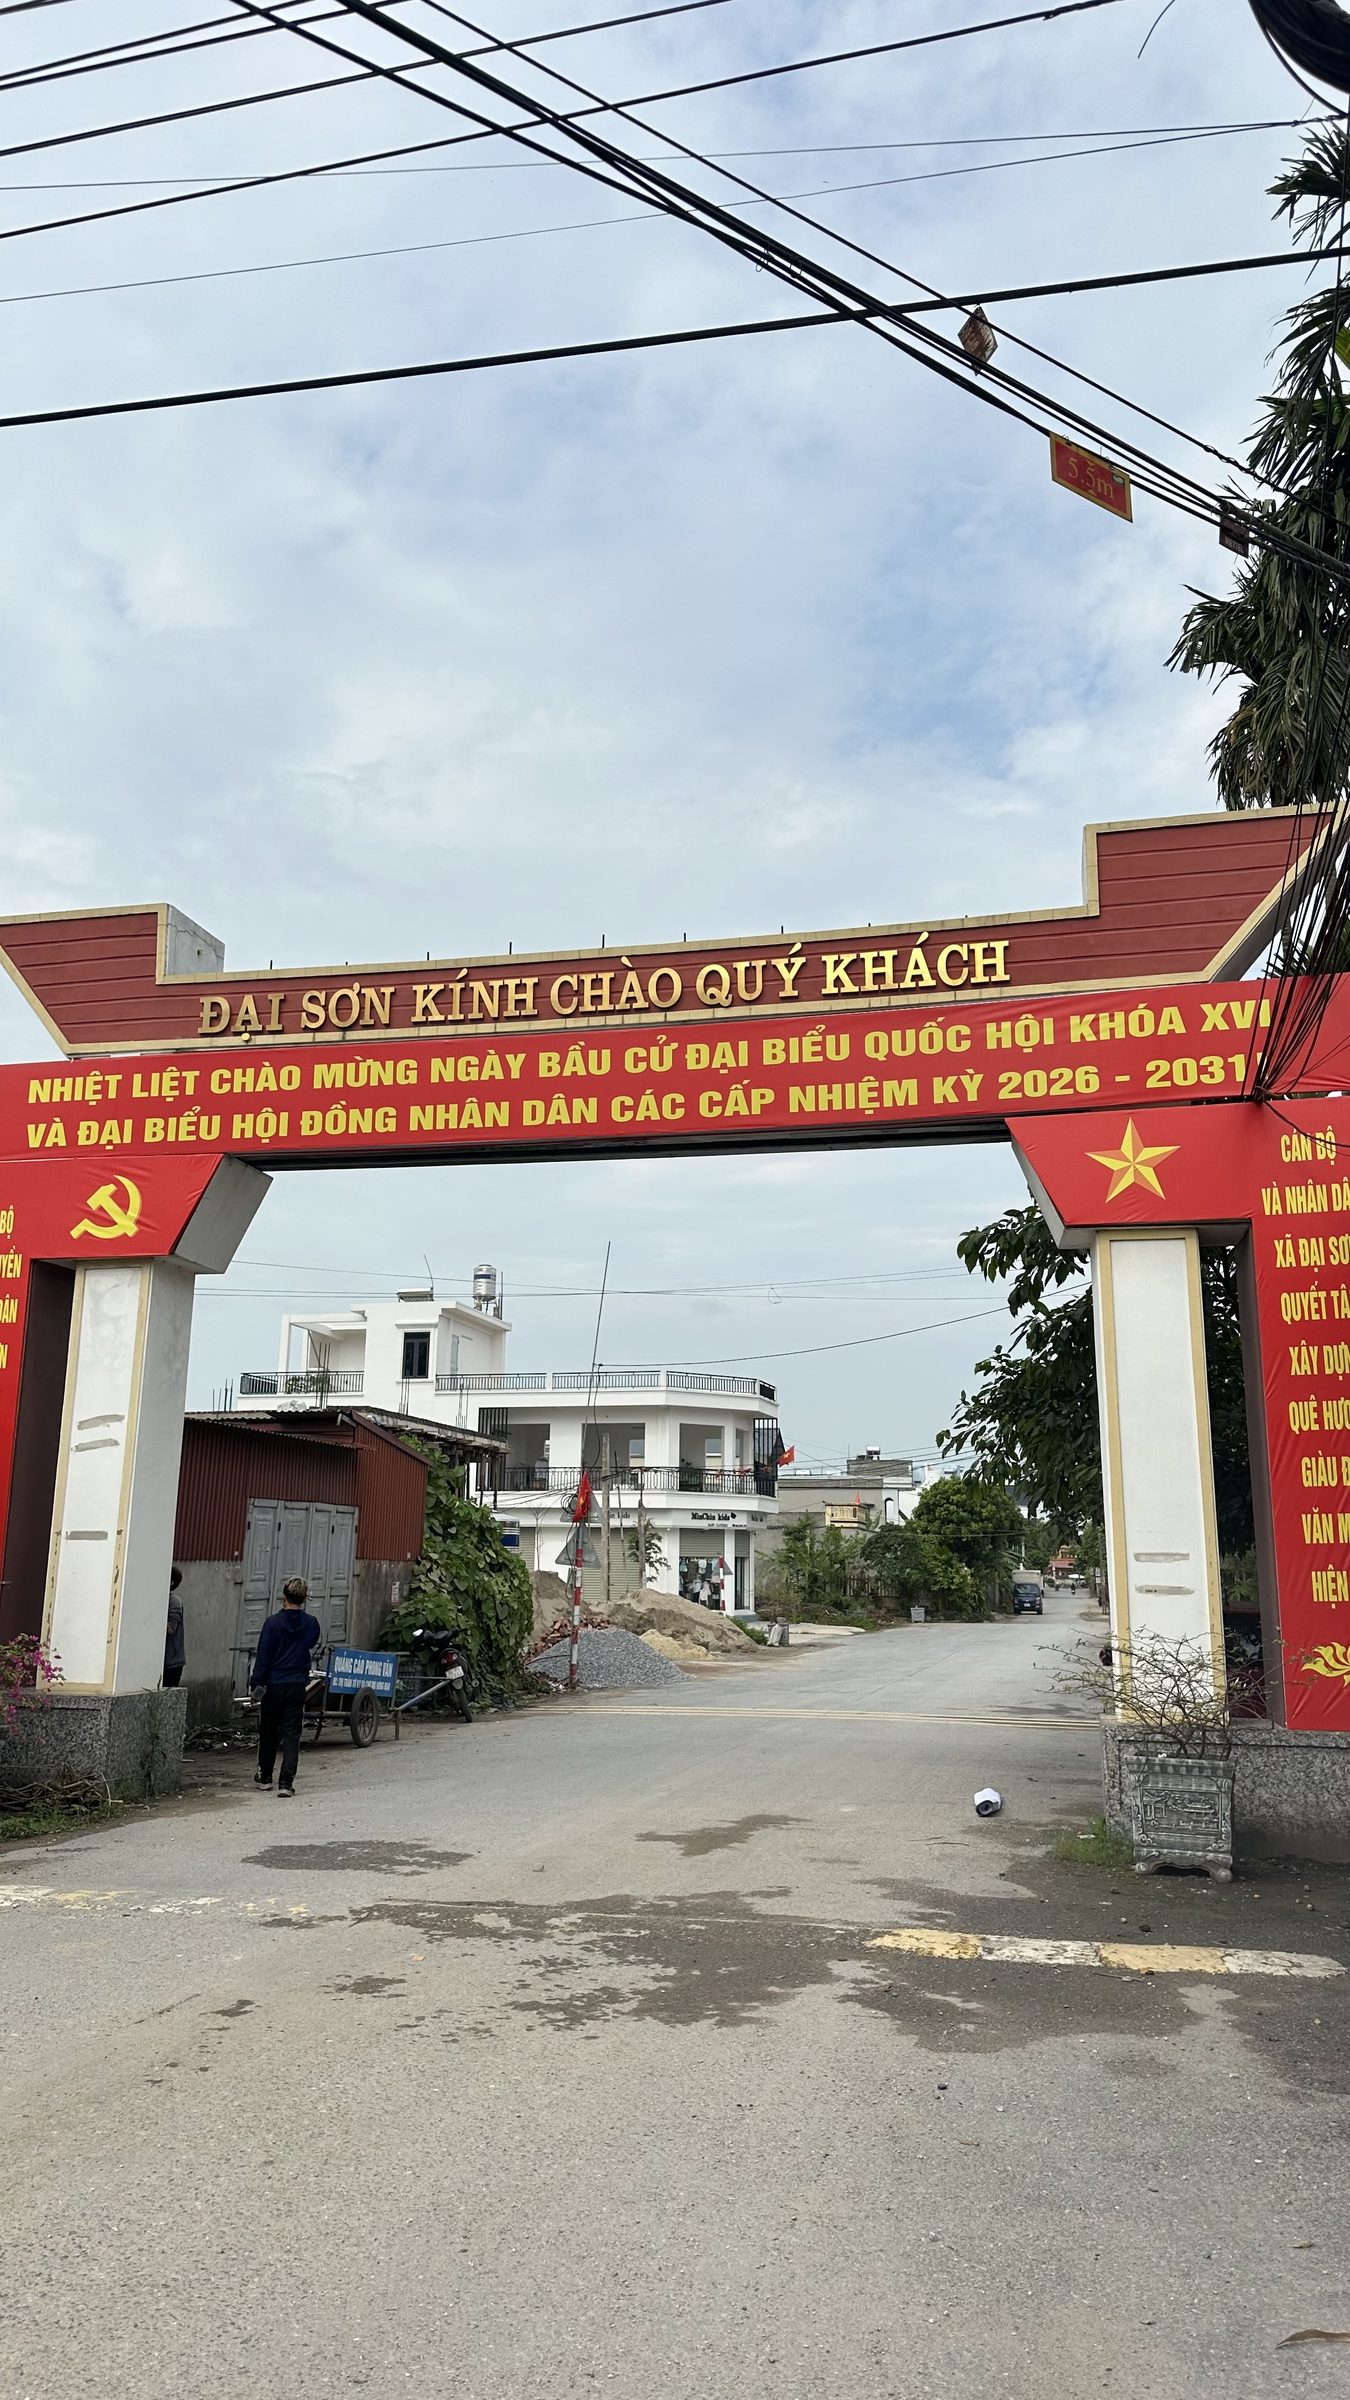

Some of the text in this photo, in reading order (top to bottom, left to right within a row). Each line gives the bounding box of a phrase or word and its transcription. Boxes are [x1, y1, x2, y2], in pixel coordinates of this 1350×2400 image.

[1068, 457, 1114, 499] 5.5m
[198, 931, 1010, 1041] ĐẠI SƠN KÍNH CHÀO QUÝ KHÁCH
[28, 999, 1271, 1104] NHIỆT LIỆT CHÀO MỪNG NGÀY BẦU CỬ ĐẠI BIỂU QUỐC HỘI KHÓA XVI
[27, 1118, 67, 1149] VÀ
[76, 1118, 133, 1151] ĐẠI
[143, 1105, 221, 1143] BIỂU
[231, 1107, 289, 1144] HỘI
[299, 1100, 397, 1136] ĐỒNG
[409, 1097, 510, 1131] NHÂN
[522, 1093, 598, 1126] DÂN
[611, 1088, 685, 1123] CÁC
[699, 1080, 775, 1118] CẤP
[788, 1075, 919, 1115] NHIỆM
[932, 1068, 984, 1104] KỲ
[998, 1066, 1100, 1100] 2026
[1145, 1054, 1246, 1089] 2031
[1280, 1125, 1337, 1166] CÁN BỘ
[1261, 1181, 1283, 1216] VÀ
[1285, 1179, 1329, 1215] NHÂN
[0, 1246, 23, 1279] YỀN
[1274, 1234, 1297, 1268] XÃ
[1299, 1238, 1326, 1272] ĐẠI
[1280, 1281, 1350, 1325] QUYẾT TÂ
[1289, 1340, 1319, 1376] XÂY
[1288, 1395, 1320, 1435] QUÊ
[1301, 1450, 1338, 1488] GIÀU
[718, 1513, 730, 1521] kids
[1301, 1507, 1335, 1545] VĂN
[1311, 1564, 1349, 1609] HIỆN
[334, 1651, 353, 1673] QUẢNG
[353, 1655, 365, 1675] CÁO
